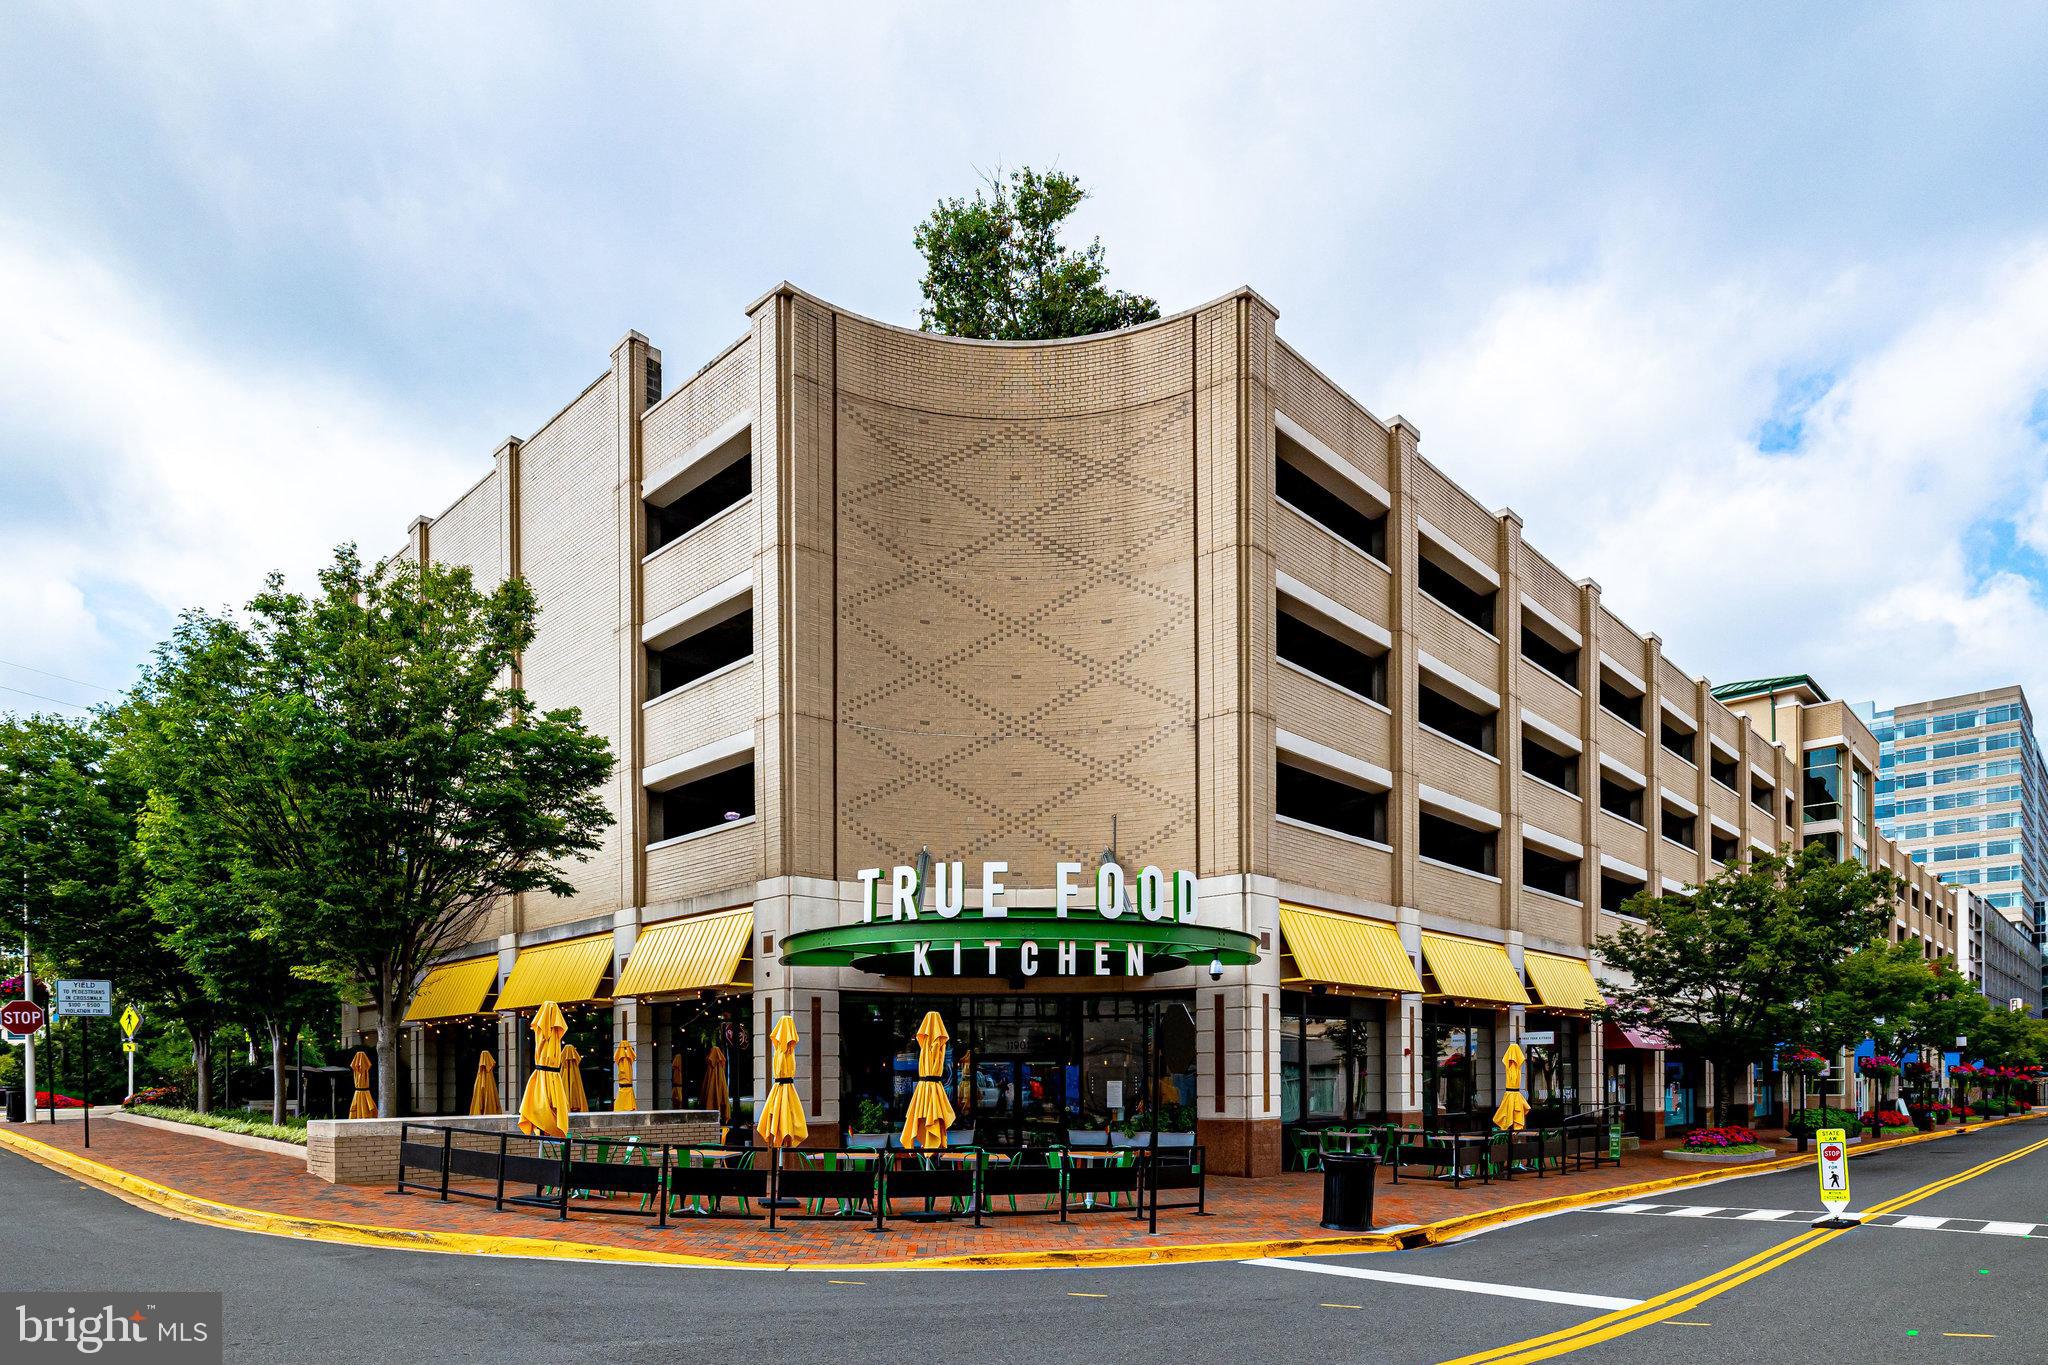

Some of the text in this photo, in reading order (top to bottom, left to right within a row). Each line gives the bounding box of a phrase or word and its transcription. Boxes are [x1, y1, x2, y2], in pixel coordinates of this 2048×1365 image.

[857, 861, 1199, 924] TRUE FOOD
[914, 939, 1144, 977] KITCHEN
[3, 1011, 41, 1025] STOP
